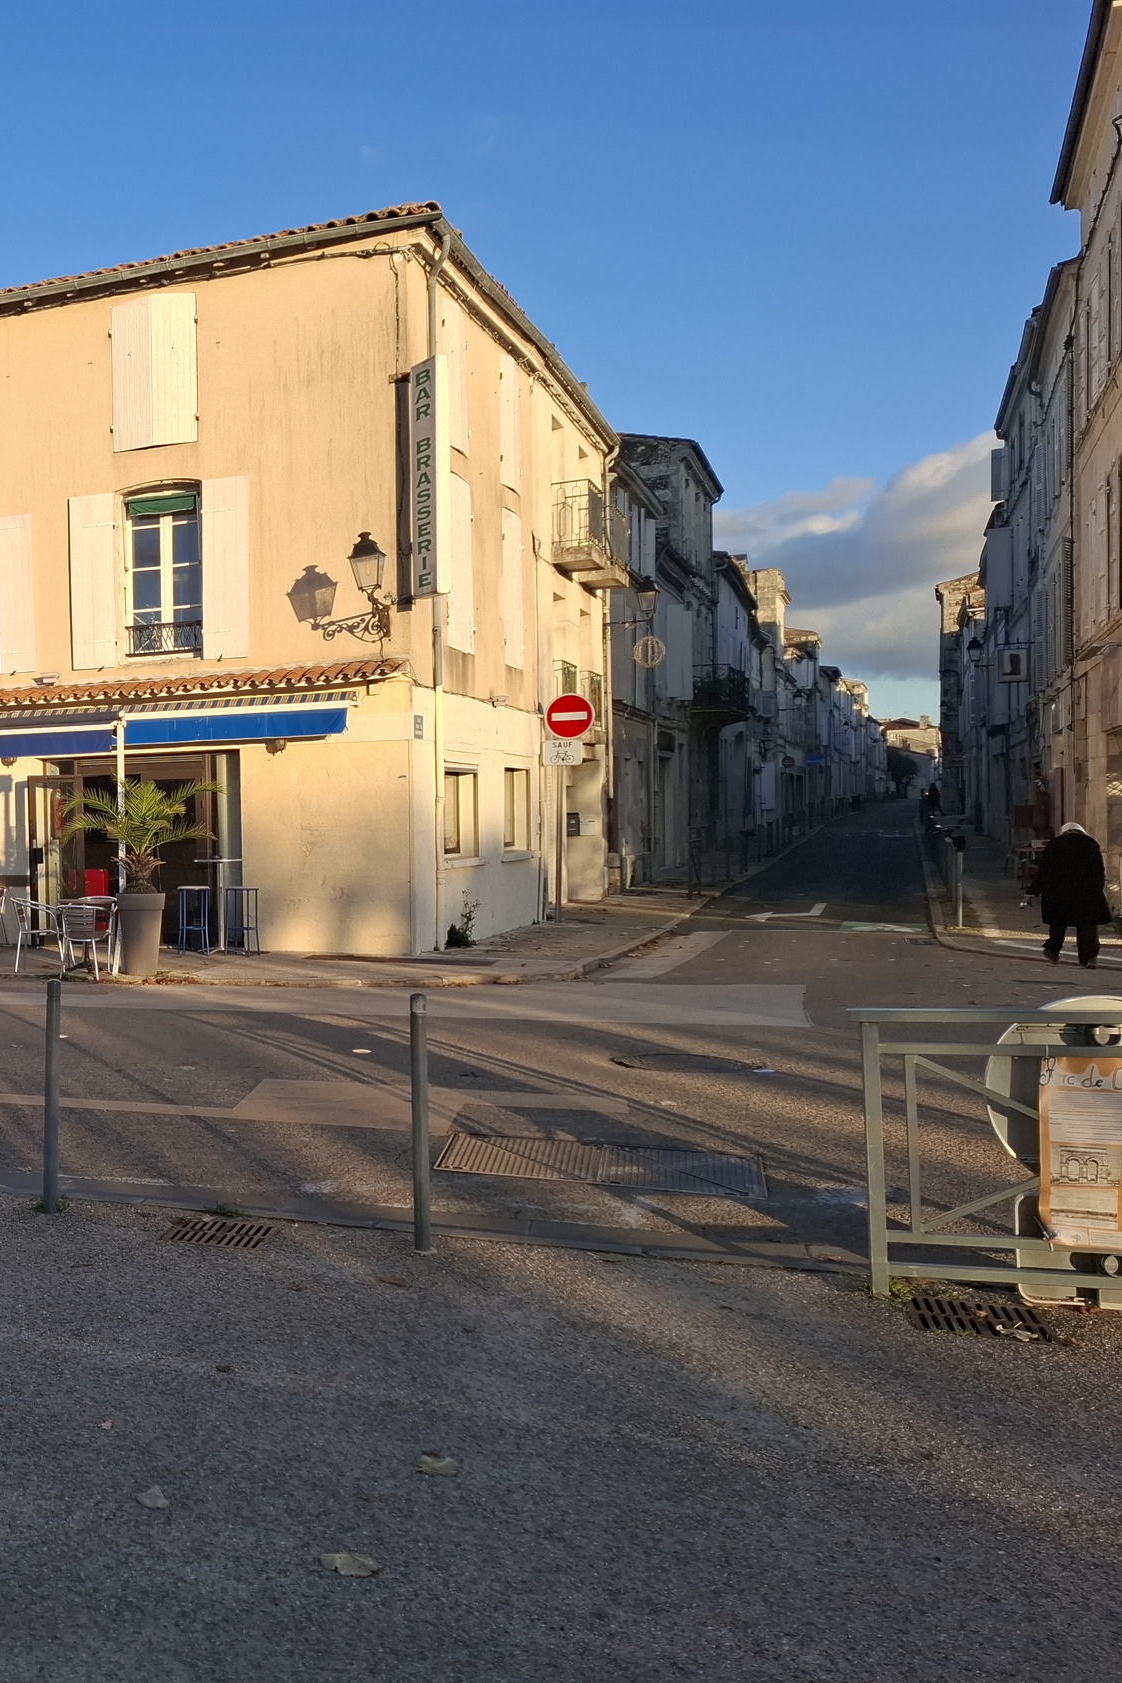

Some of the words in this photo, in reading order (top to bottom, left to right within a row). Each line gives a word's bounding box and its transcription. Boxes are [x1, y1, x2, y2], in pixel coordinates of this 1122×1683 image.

[415, 368, 431, 421] BAR
[416, 437, 432, 588] BRASSERIE
[552, 741, 573, 749] SAUF
